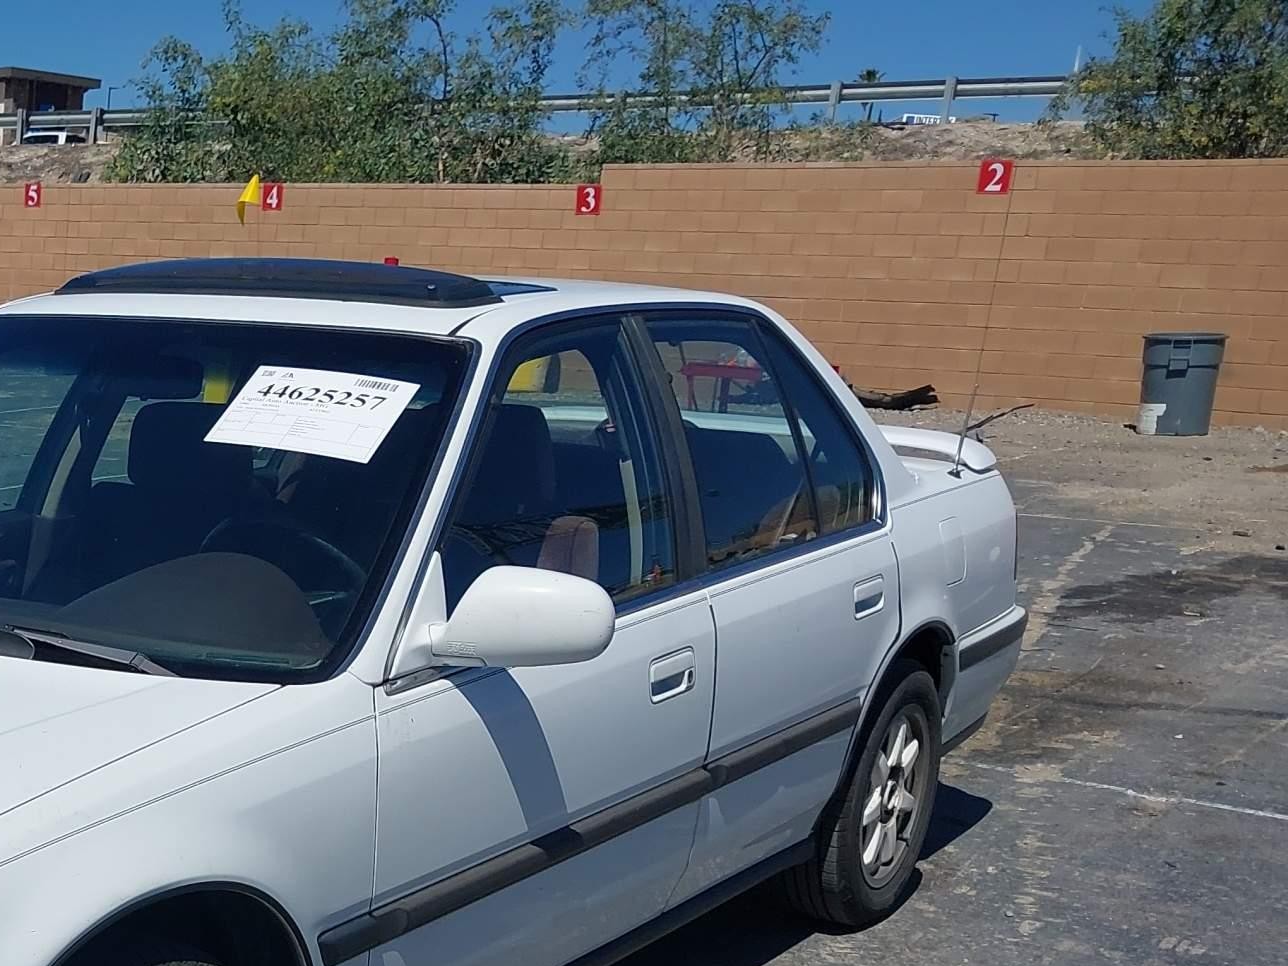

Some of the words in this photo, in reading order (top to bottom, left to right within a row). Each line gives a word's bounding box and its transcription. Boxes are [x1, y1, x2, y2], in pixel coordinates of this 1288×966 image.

[984, 162, 1004, 192] 2
[28, 185, 38, 206] 5
[266, 185, 278, 208] 4
[581, 187, 596, 212] 3
[257, 383, 387, 410] 44625257
